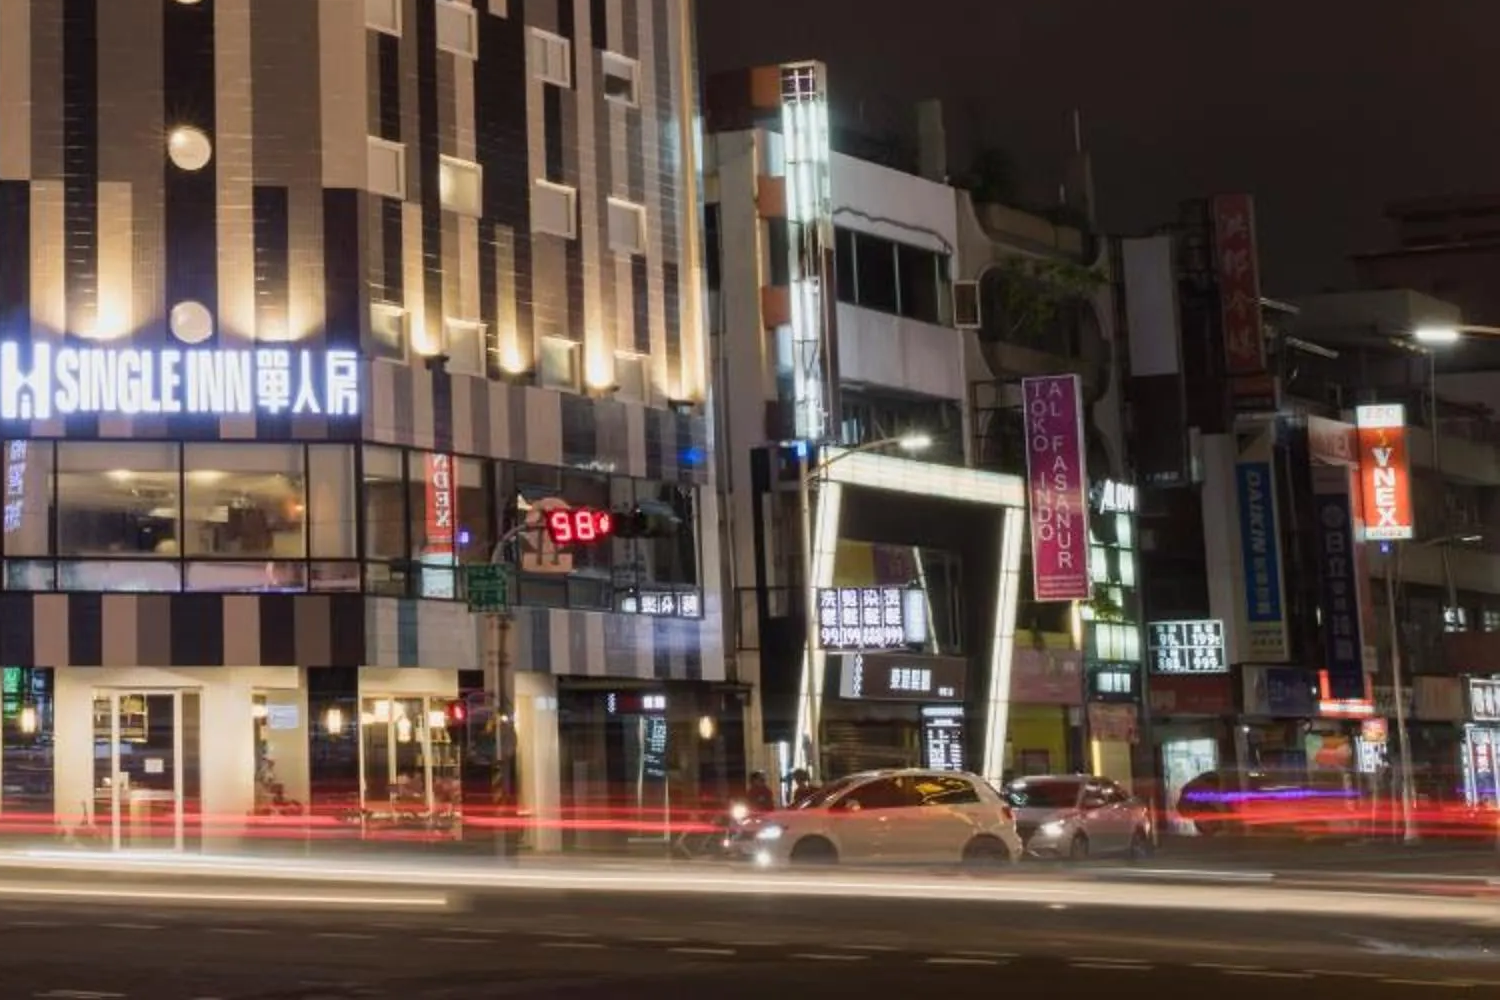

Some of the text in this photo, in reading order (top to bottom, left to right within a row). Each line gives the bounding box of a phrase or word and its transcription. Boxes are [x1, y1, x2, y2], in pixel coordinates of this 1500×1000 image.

[56, 348, 180, 414] SINGLE
[186, 349, 253, 414] INN
[256, 348, 359, 415] 單人房
[1031, 382, 1054, 541] TOKO INDO
[1049, 381, 1073, 569] AL FASANUR
